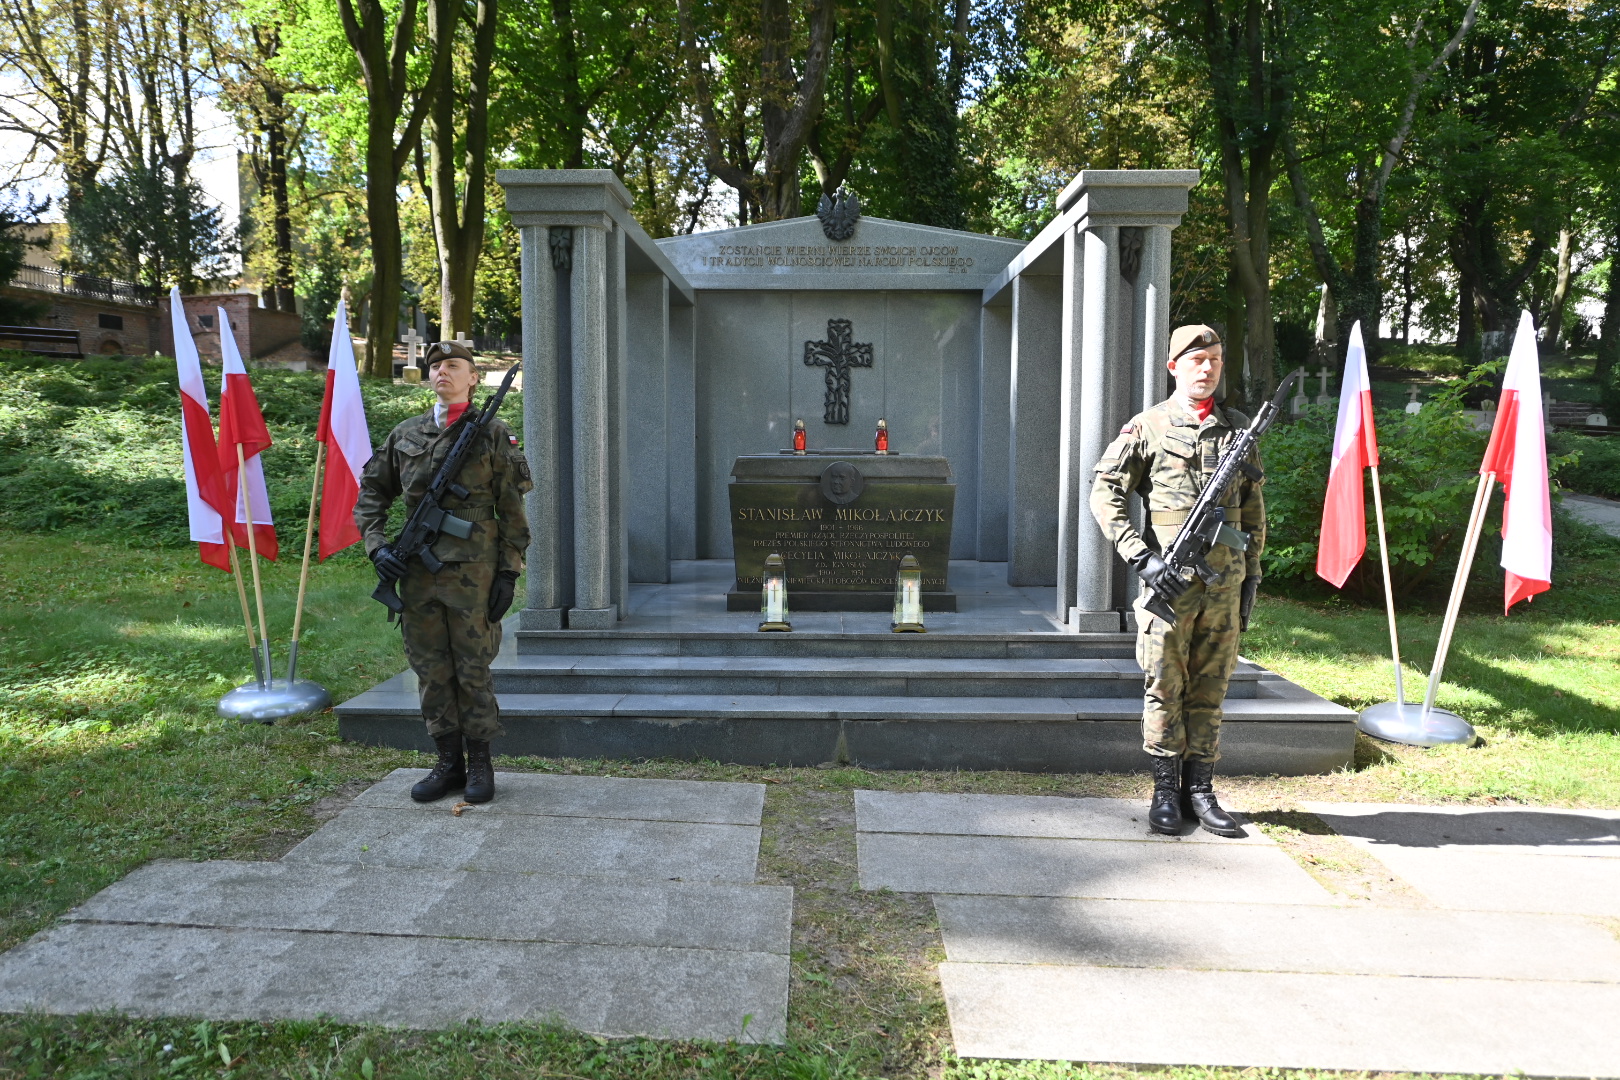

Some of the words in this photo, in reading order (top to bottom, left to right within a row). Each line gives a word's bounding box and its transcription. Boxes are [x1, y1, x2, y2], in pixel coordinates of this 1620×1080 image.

[786, 246, 824, 256] WIERNI
[828, 246, 871, 256] WIERZE
[874, 246, 916, 256] SWOICH
[858, 257, 904, 268] NARODU
[908, 257, 974, 268] POLSKIEGO
[738, 508, 823, 521] STANISŁAW
[835, 508, 945, 522] MIKOŁAJCZYK
[780, 552, 825, 560] CECYLIA
[834, 552, 901, 560] MIKOŁAJCZYK
[836, 576, 867, 584] OBOZÓW
